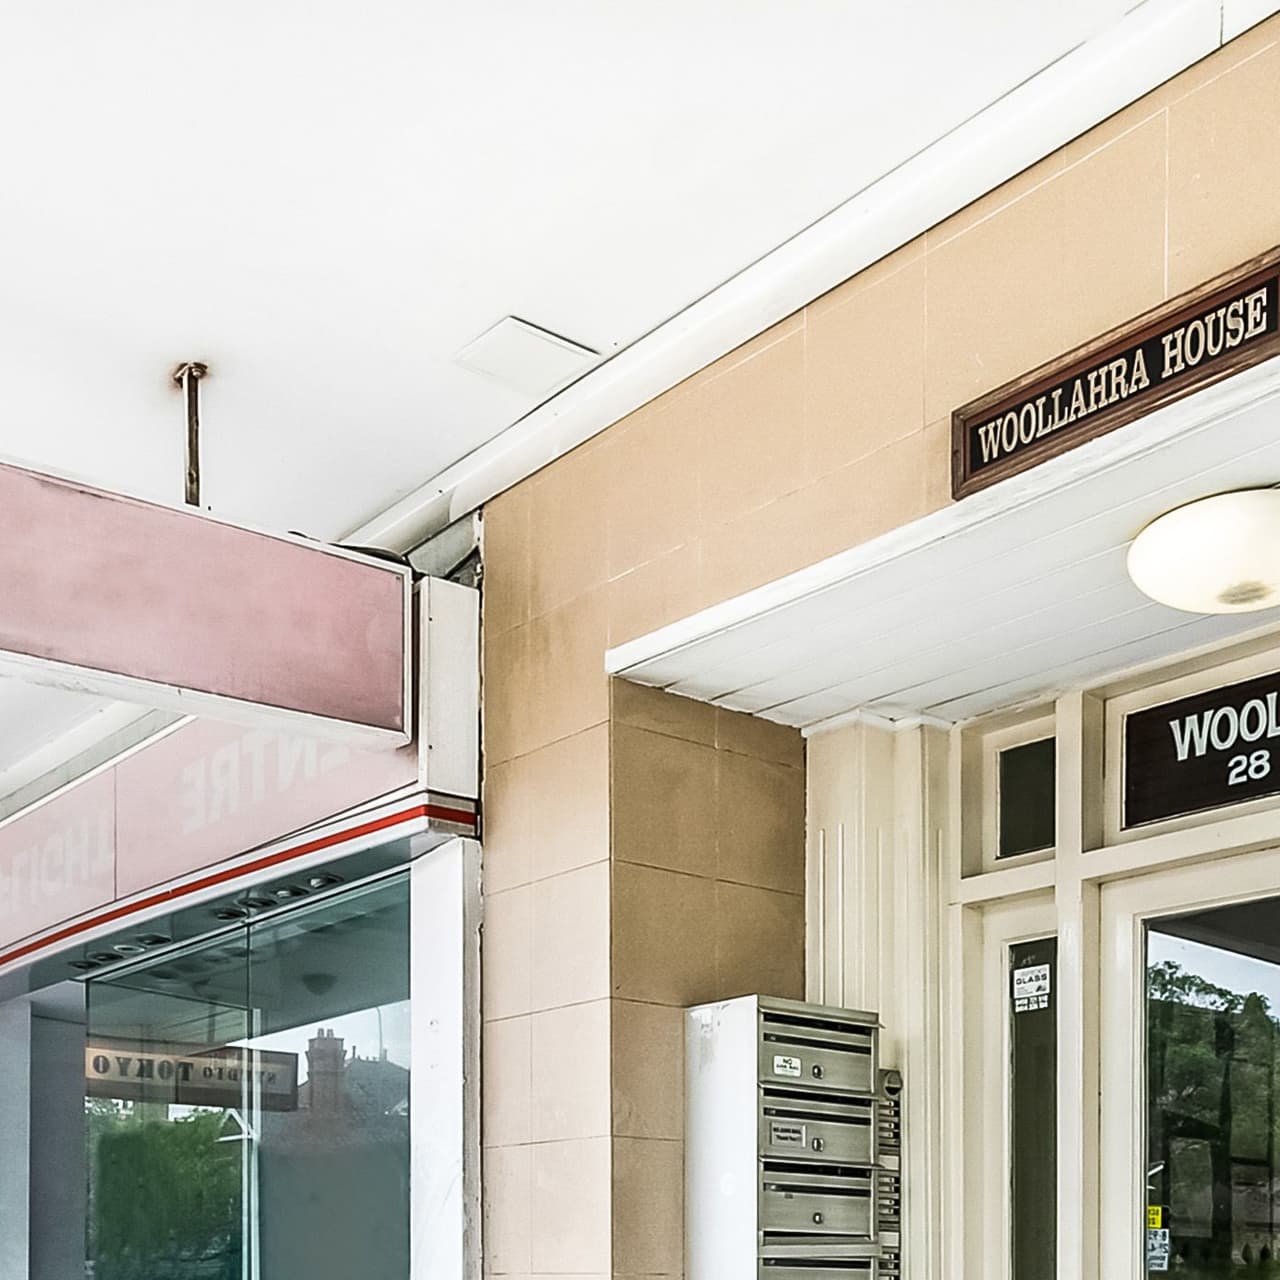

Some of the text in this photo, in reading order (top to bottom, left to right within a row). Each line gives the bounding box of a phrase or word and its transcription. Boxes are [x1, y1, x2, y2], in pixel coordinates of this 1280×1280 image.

[978, 287, 1267, 463] WOOLLAHRA HOUSE
[1227, 749, 1272, 786] 28
